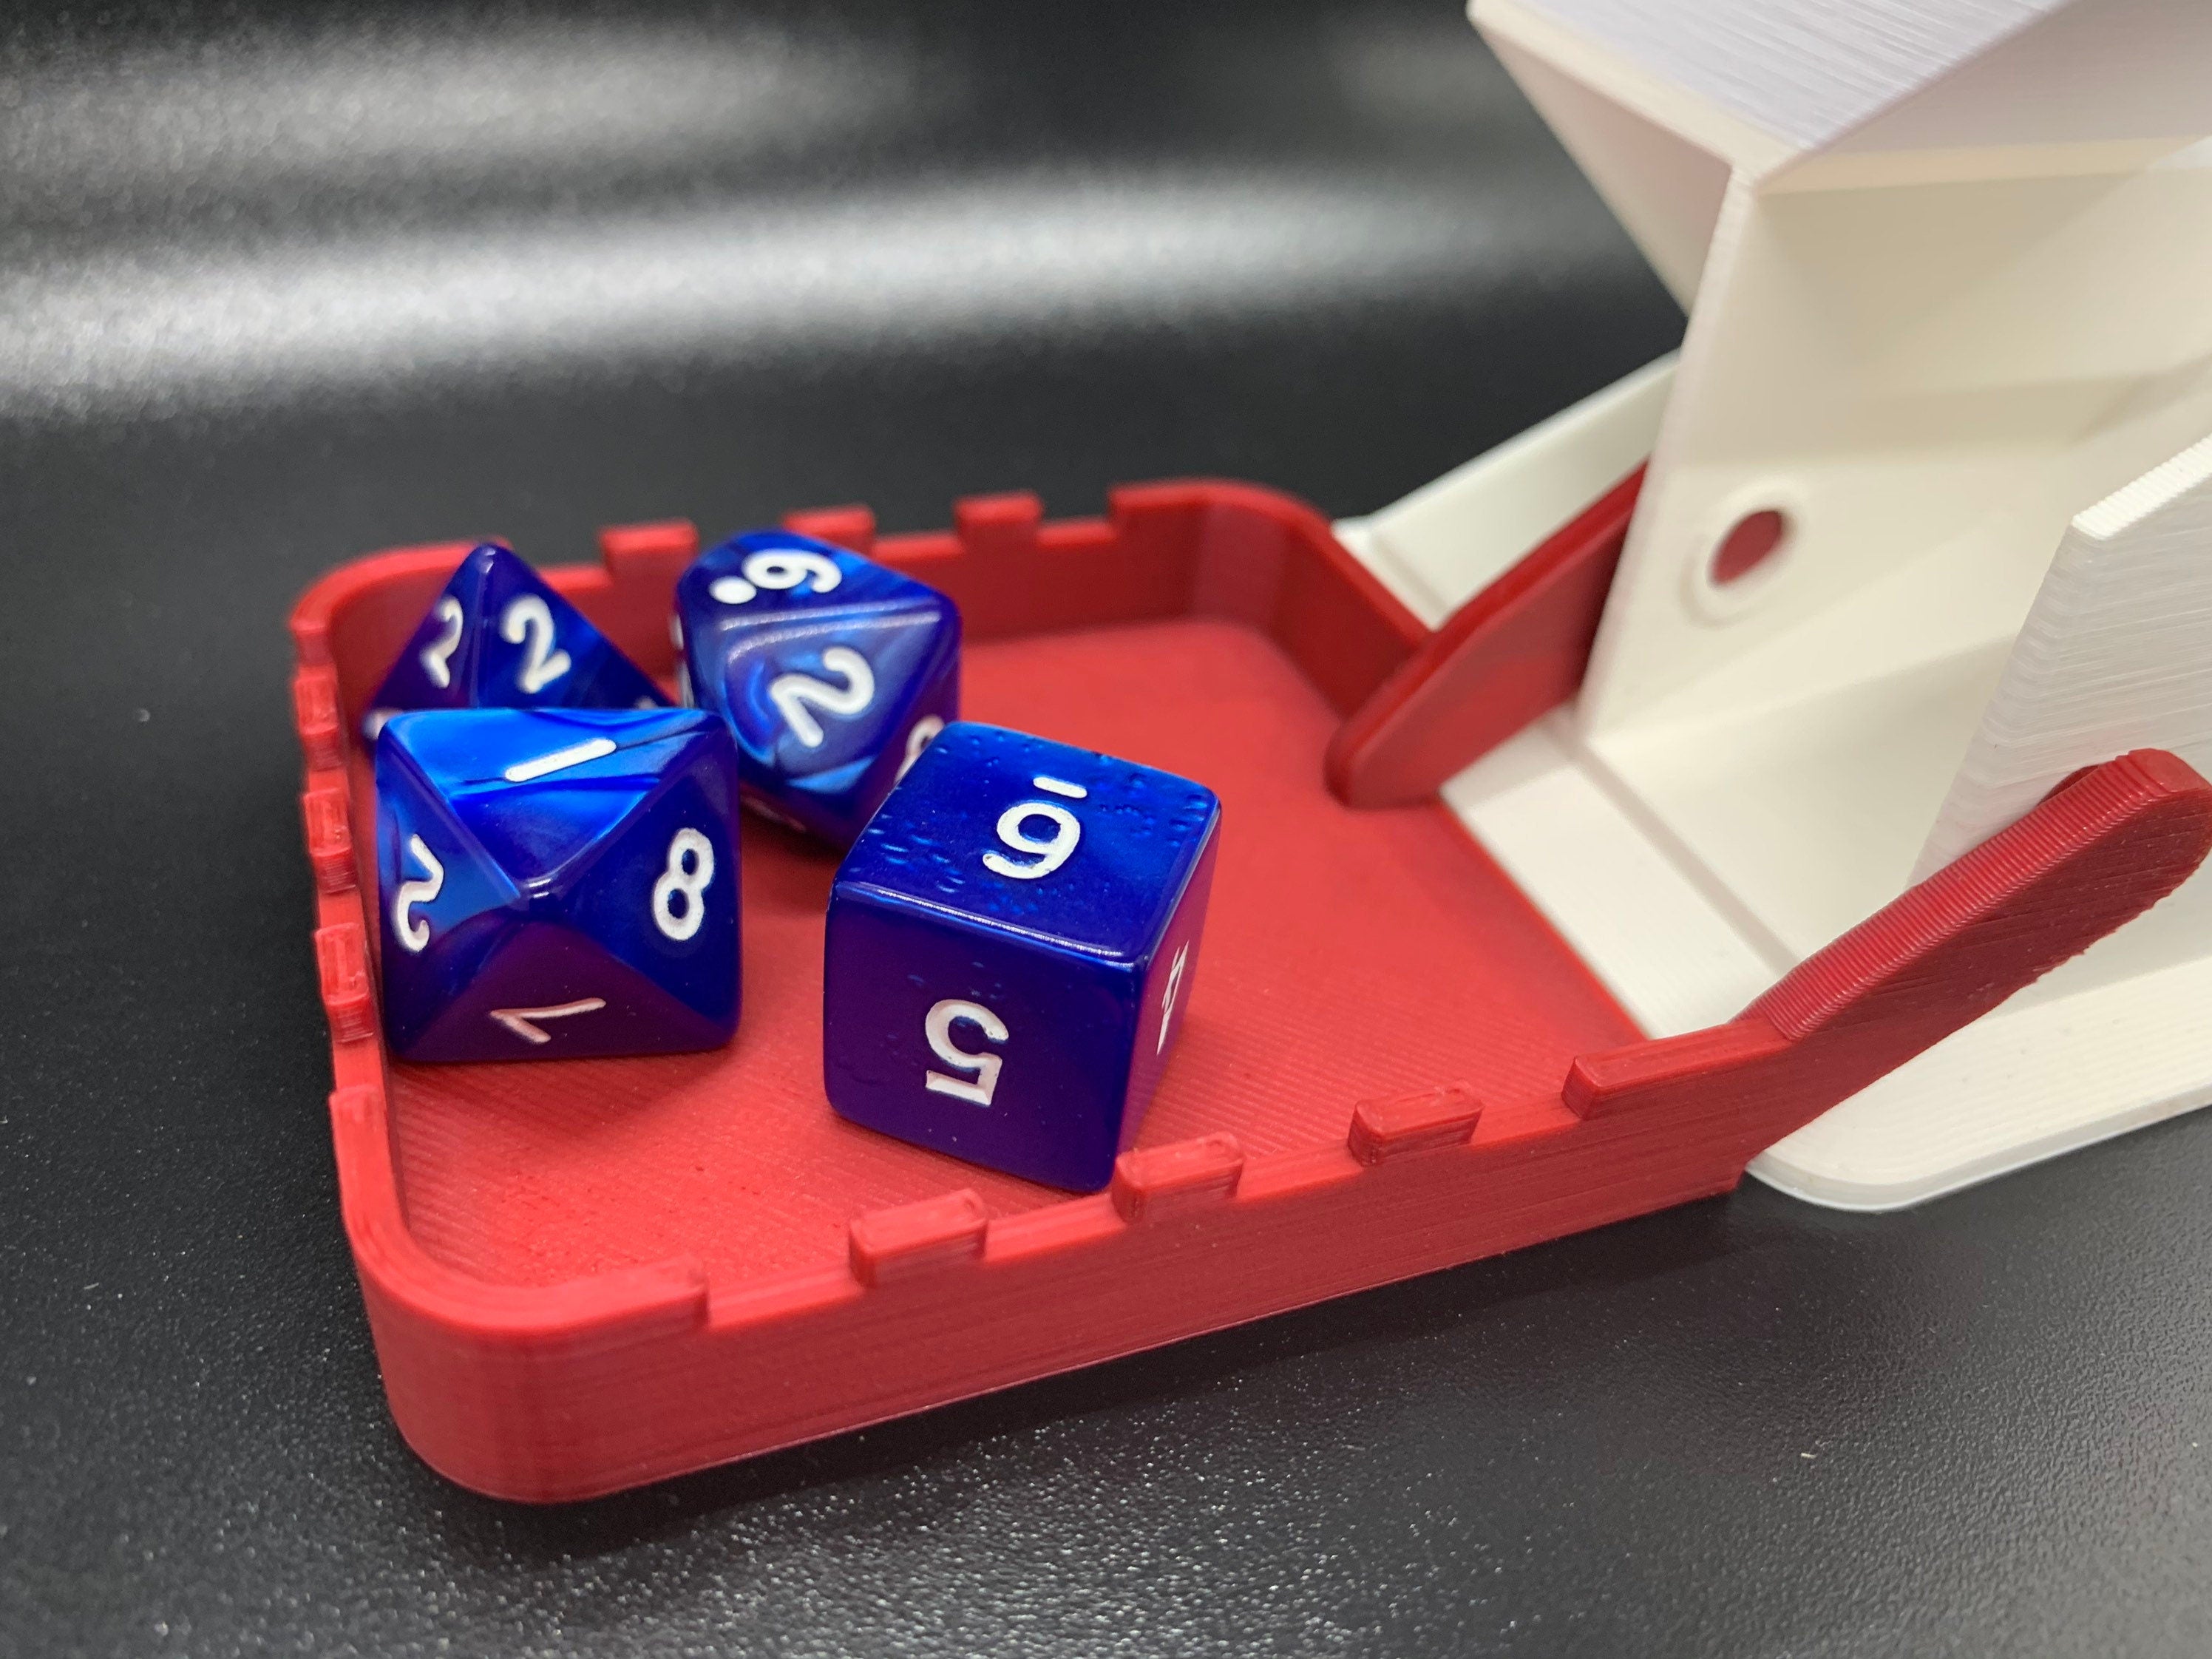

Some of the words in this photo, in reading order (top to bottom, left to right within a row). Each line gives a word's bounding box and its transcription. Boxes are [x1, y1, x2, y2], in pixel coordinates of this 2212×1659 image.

[500, 594, 572, 694] 2
[768, 645, 875, 748] 2
[394, 833, 445, 953] 2
[652, 827, 715, 941] 8
[924, 998, 1010, 1107] 5
[1156, 939, 1190, 1056] 4
